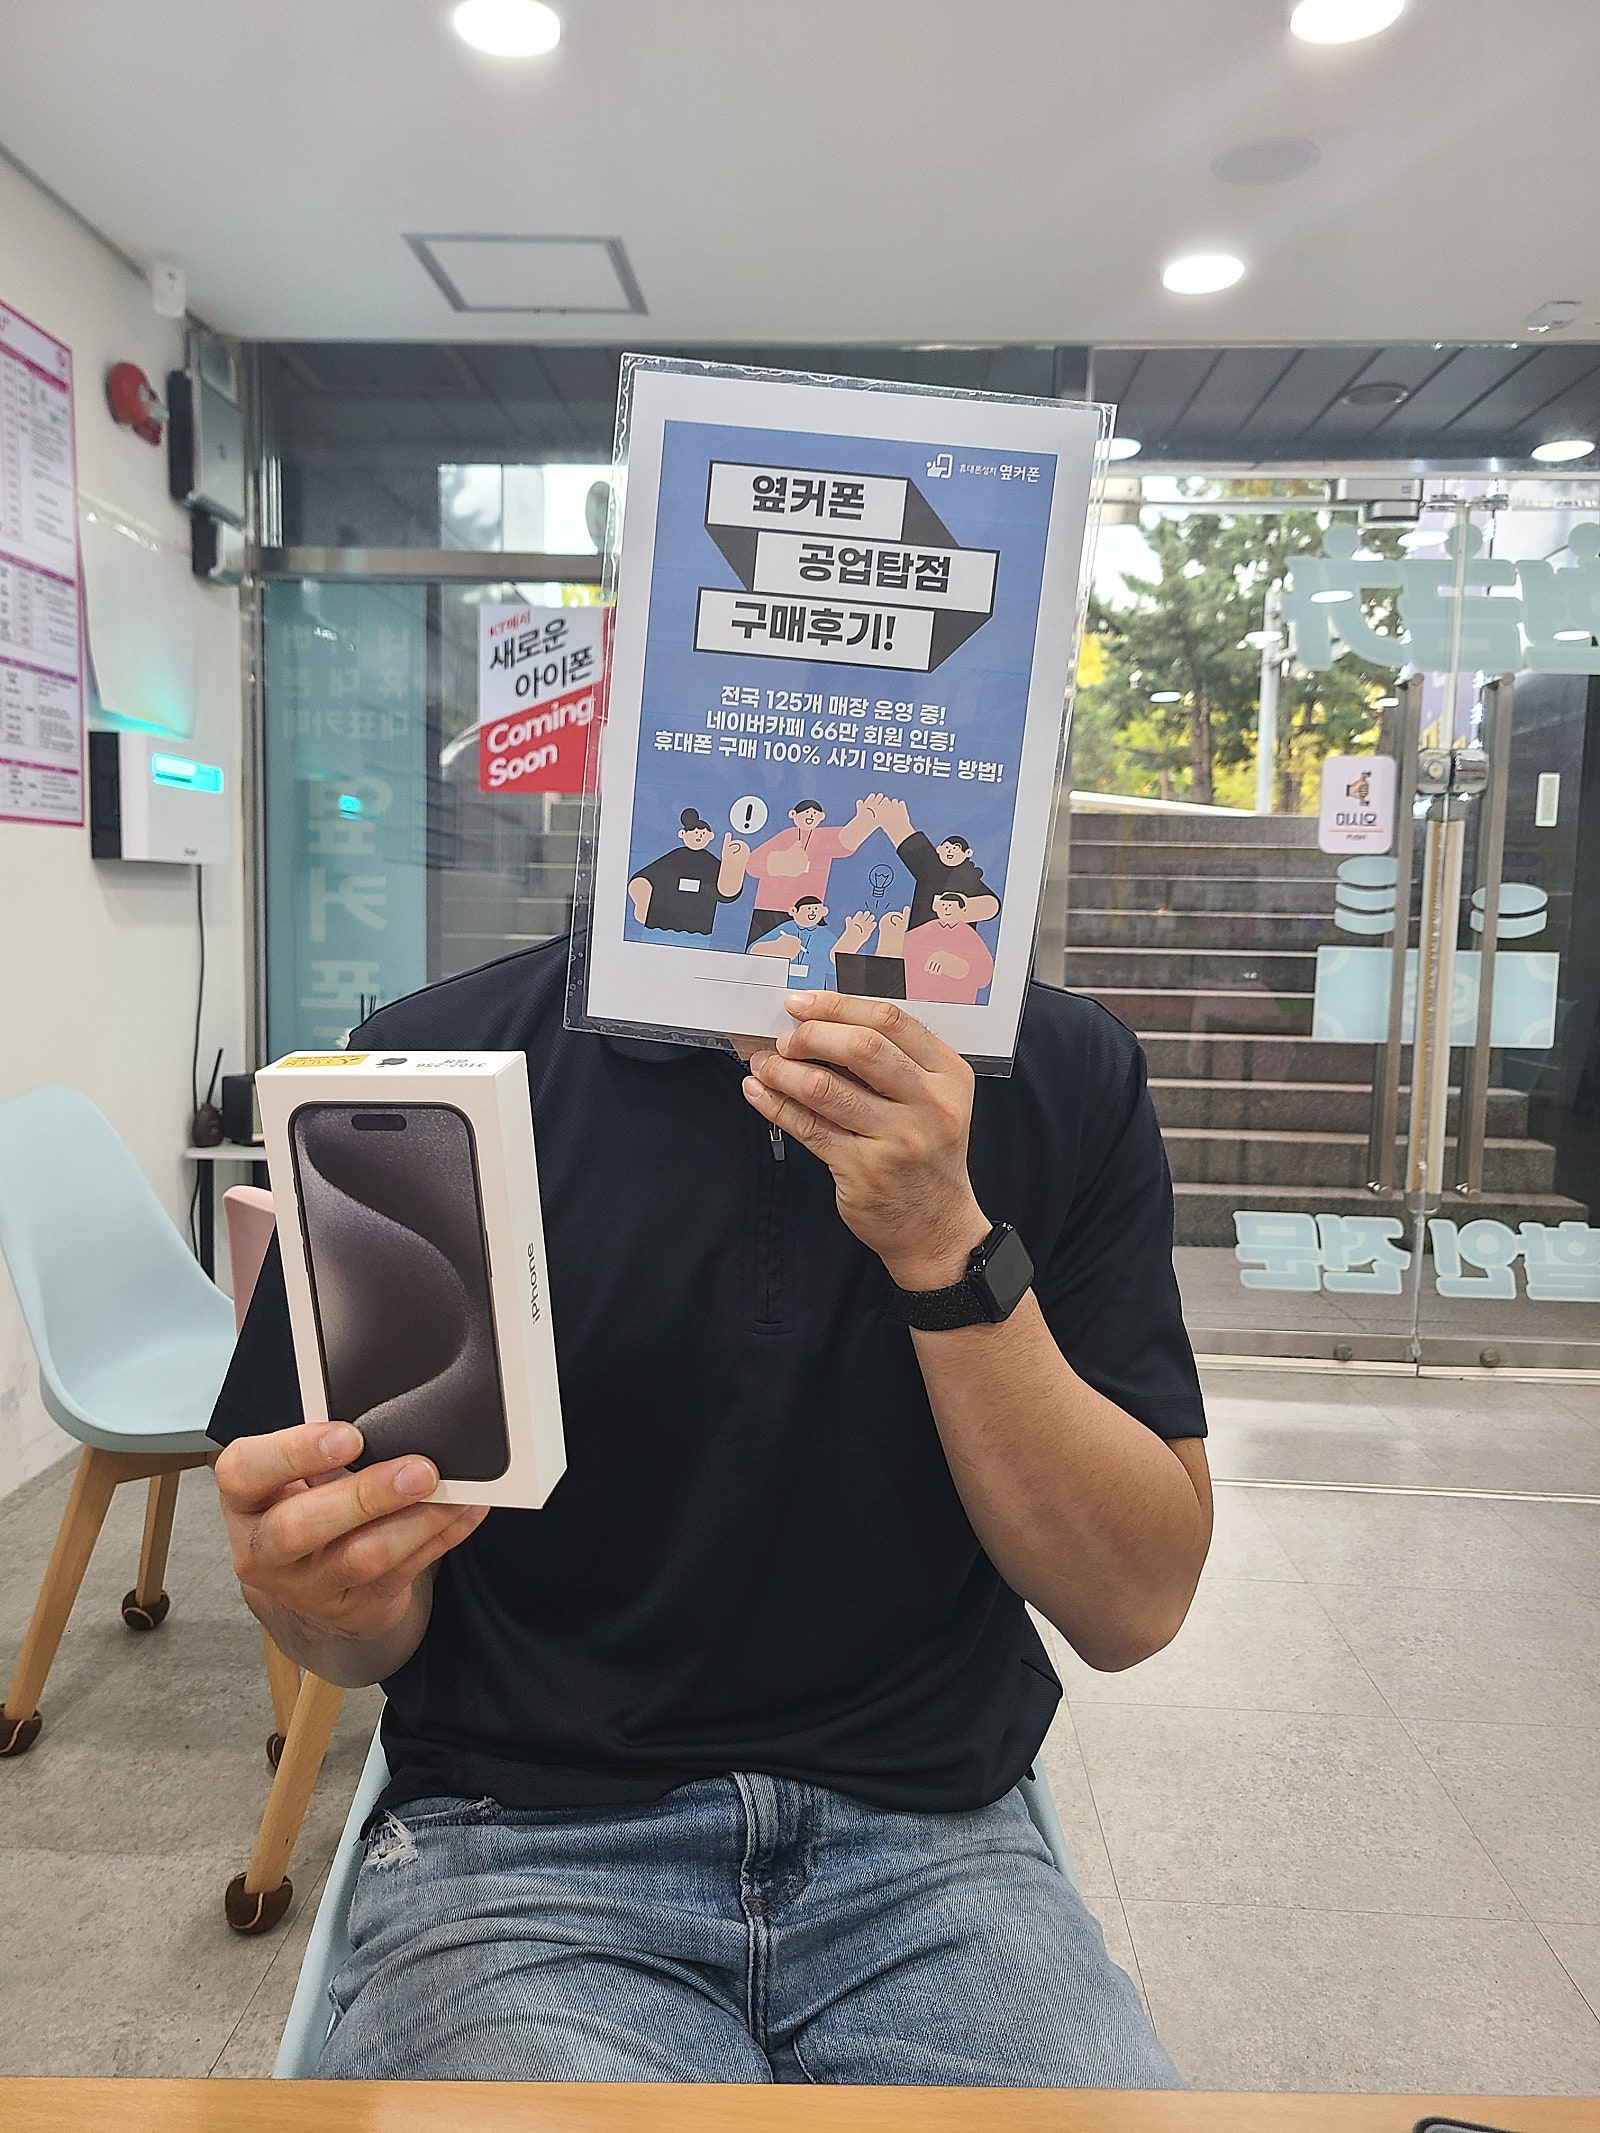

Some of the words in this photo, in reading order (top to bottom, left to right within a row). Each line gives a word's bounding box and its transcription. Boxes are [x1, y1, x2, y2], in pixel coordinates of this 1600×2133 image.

[752, 475, 865, 521] 옆커폰
[999, 464, 1041, 483] 옆커폰
[798, 543, 952, 594] 공업탑점
[490, 617, 569, 670] 새로운
[731, 601, 897, 651] 구매후기!
[515, 645, 596, 699] 아이폰
[487, 694, 597, 754] Coming
[721, 685, 761, 709] 전국
[765, 690, 822, 714] 125개
[828, 695, 869, 720] 매장
[873, 699, 914, 722] 운영
[919, 703, 947, 727] 중!
[706, 710, 805, 738] 네이버카페
[810, 719, 859, 745] 66만
[863, 724, 904, 748] 회원
[910, 729, 957, 753] 인증!
[488, 743, 559, 787] Soon
[653, 730, 713, 756] 휴대폰
[718, 736, 758, 760] 구매
[763, 741, 821, 766] 100%
[826, 746, 867, 770] 사기
[872, 750, 952, 778] 안당하는
[958, 758, 1005, 784] 방법!
[1336, 811, 1377, 827] 미시오
[526, 1242, 542, 1325] iPhone
